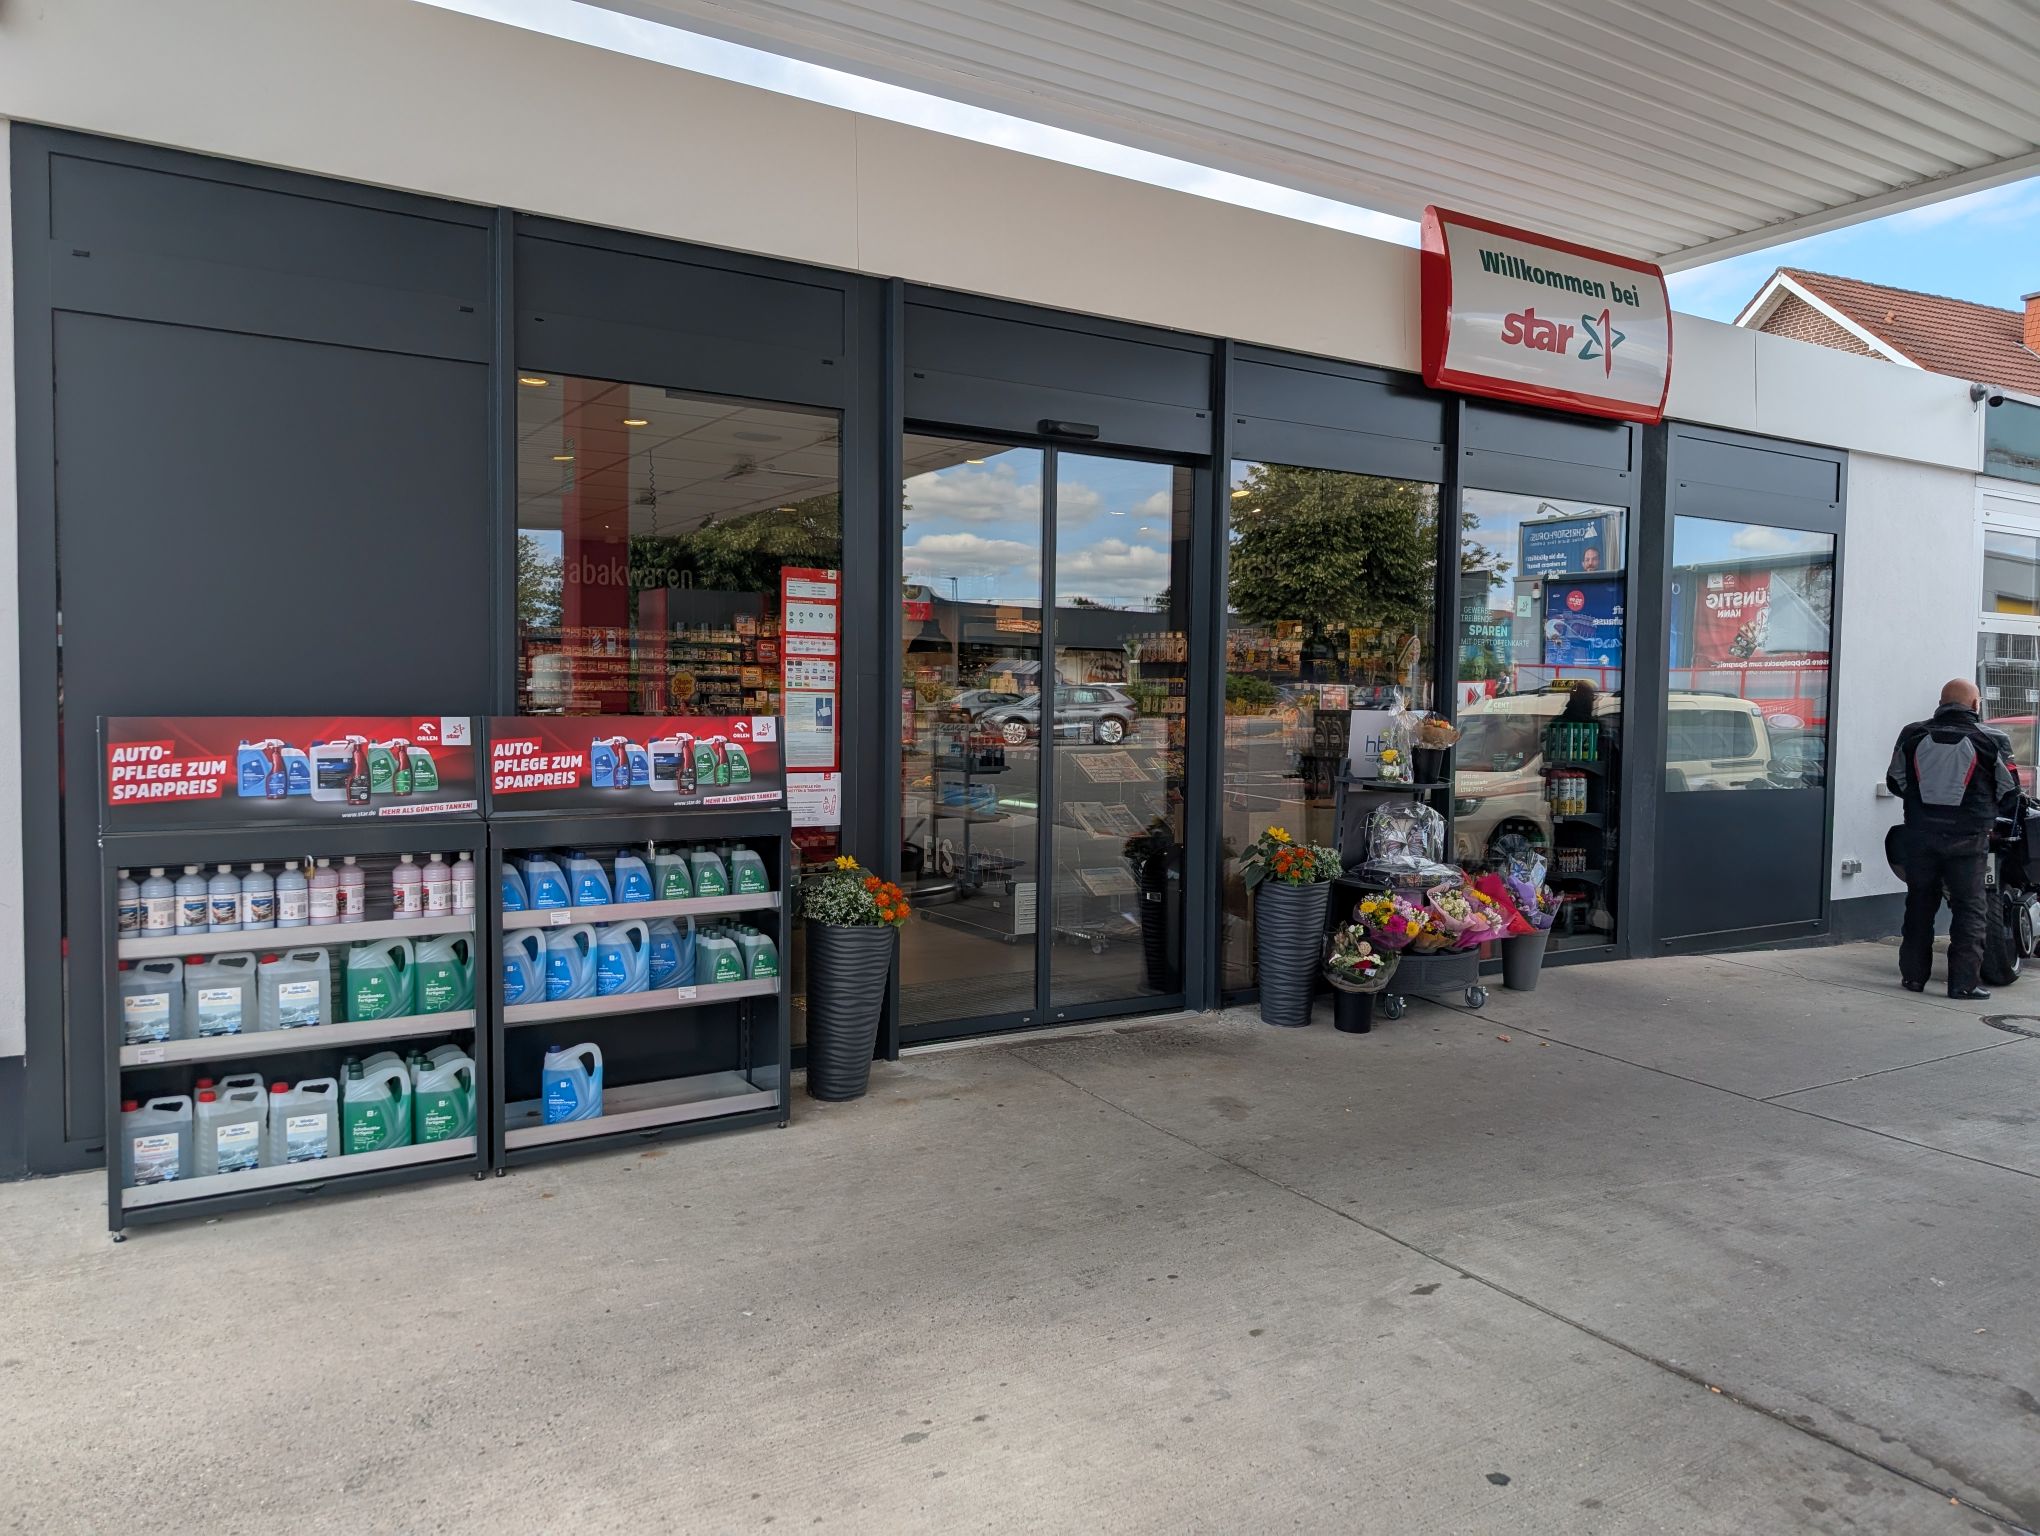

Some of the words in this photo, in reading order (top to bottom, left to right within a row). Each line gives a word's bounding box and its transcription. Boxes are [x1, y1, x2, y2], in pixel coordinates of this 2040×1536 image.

[1479, 249, 1606, 299] Willkommen
[1610, 281, 1640, 307] bei
[1501, 307, 1574, 354] star
[565, 555, 693, 589] abakwaren
[1468, 624, 1508, 636] SPAREN
[112, 746, 171, 762] AUTO-
[494, 744, 539, 756] AUTO-
[112, 762, 183, 781] PFLEGE
[186, 760, 226, 777] ZUM
[494, 758, 548, 772] PFLEGE
[551, 755, 582, 768] ZUM
[112, 779, 218, 800] SPARPREIS
[494, 771, 576, 790] SPARPREIS
[416, 804, 444, 812] GÜNSTIG
[445, 802, 473, 810] TANKEN!
[733, 794, 756, 802] GÜNSTIG
[924, 835, 953, 873] EIS
